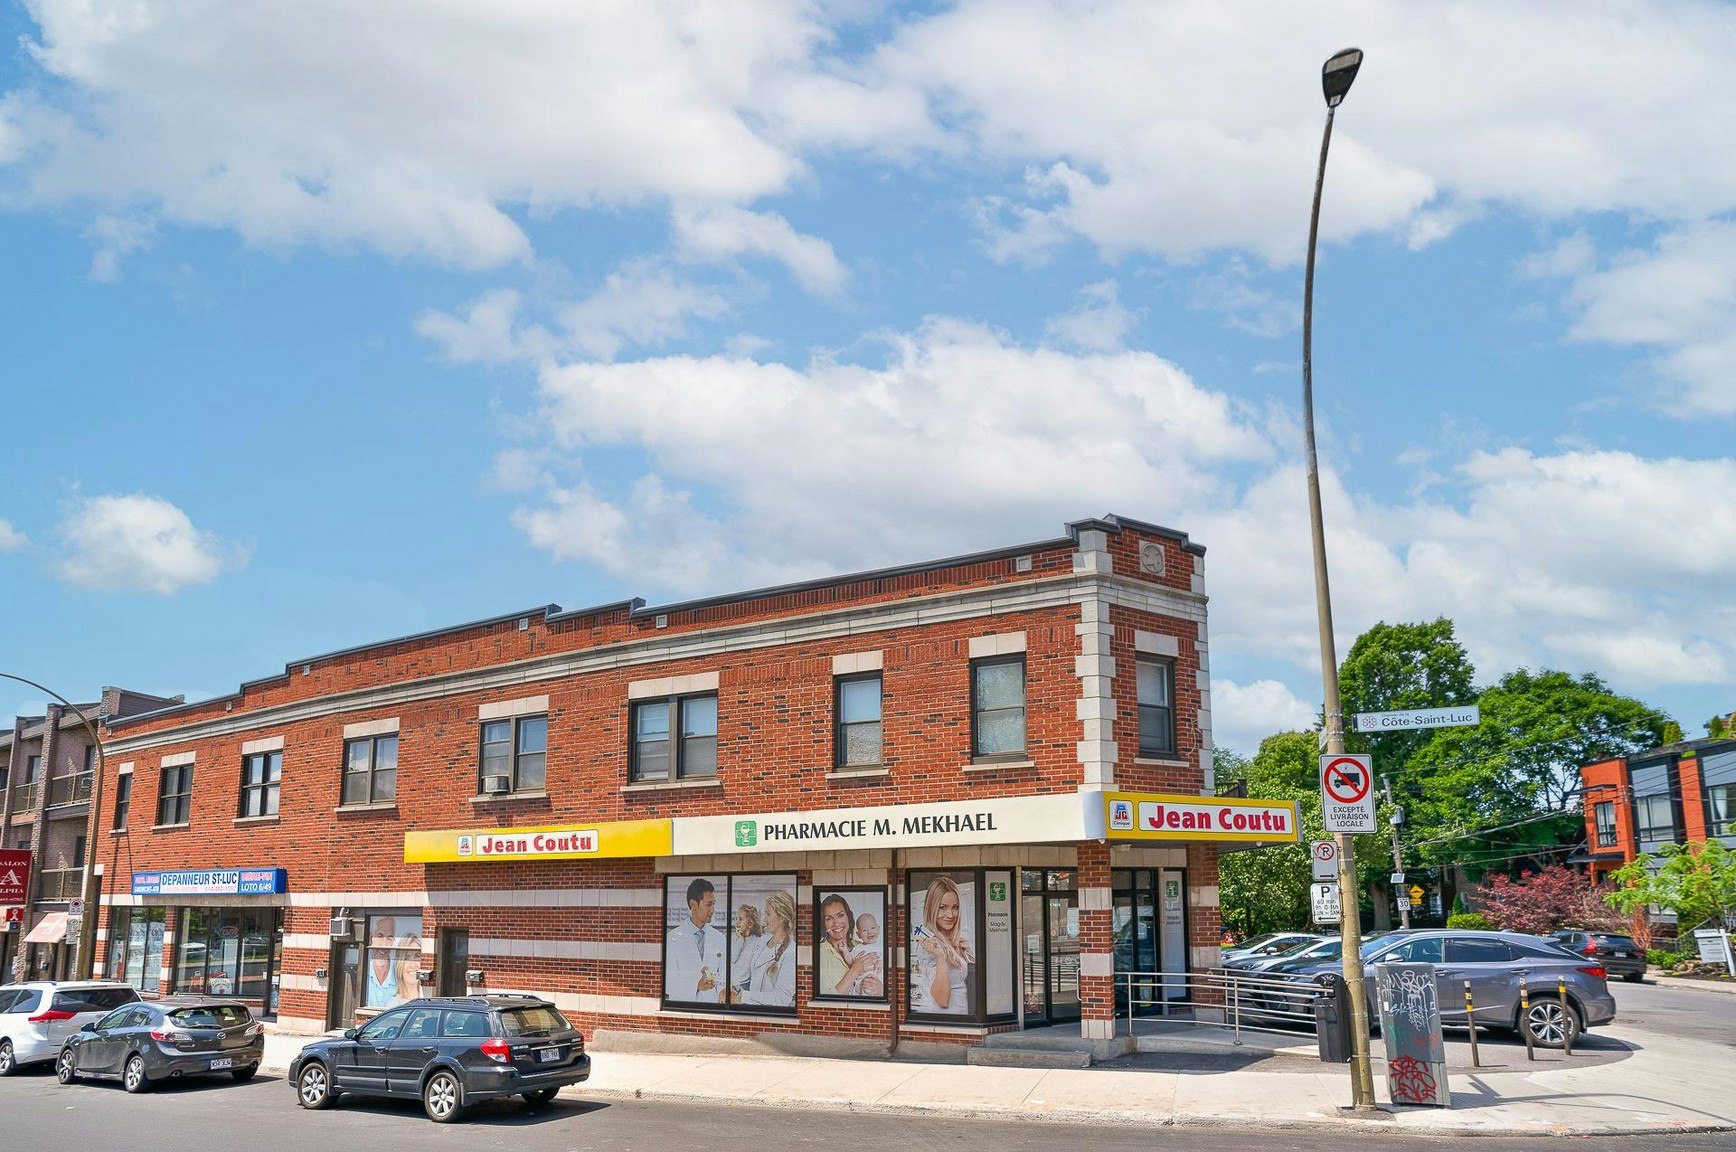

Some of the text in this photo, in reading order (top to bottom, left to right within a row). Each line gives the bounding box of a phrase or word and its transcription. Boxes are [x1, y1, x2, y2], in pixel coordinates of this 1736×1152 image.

[1381, 713, 1473, 727] Côte-Saint-Luc
[1333, 805, 1365, 813] EXCEPTÉ
[1148, 805, 1285, 831] Jean Coutu
[764, 812, 997, 841] PHARMACIE M. MEKHAEL
[482, 834, 592, 854] Jean Coutu
[162, 872, 210, 886] DEPANNEUR
[211, 871, 238, 885] ST-LUC
[241, 883, 258, 892] LOTO
[1321, 886, 1331, 898] P
